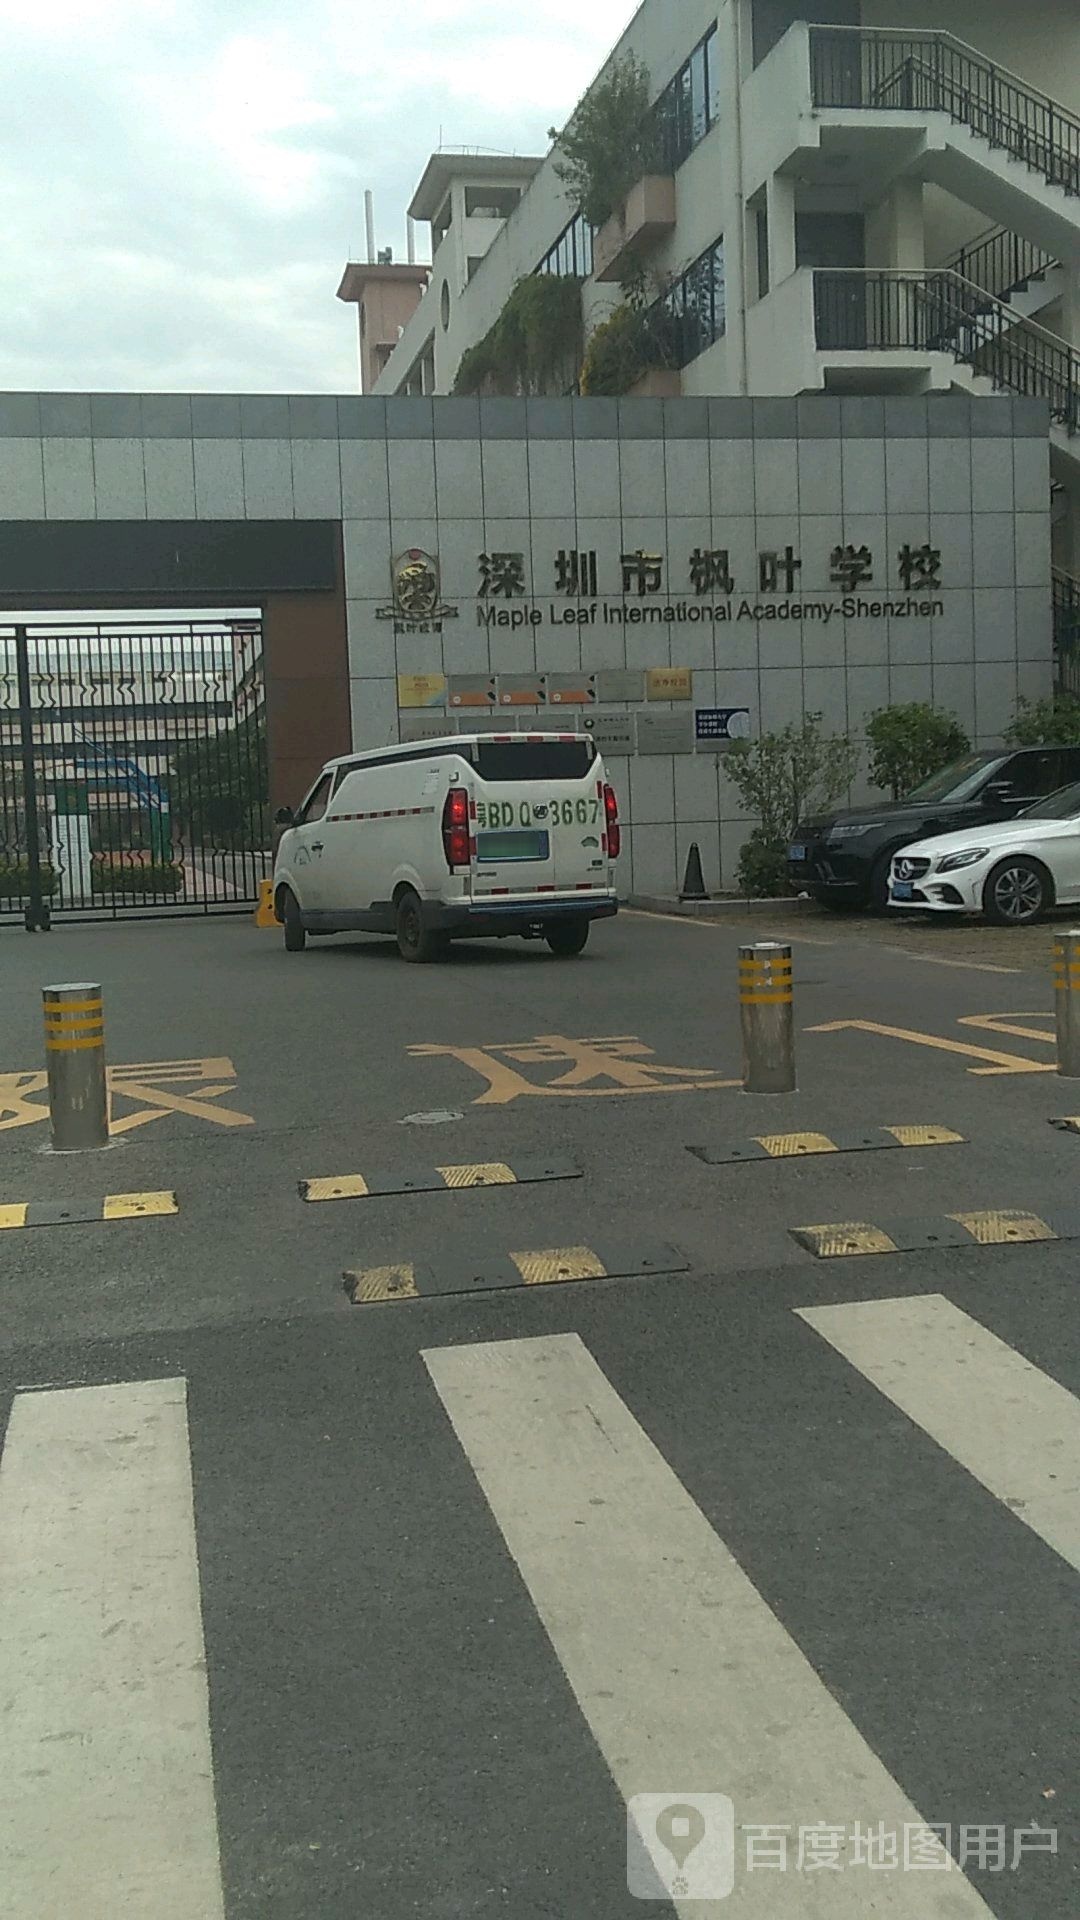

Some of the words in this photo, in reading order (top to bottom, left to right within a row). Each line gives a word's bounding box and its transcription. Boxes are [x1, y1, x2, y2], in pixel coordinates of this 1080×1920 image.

[477, 545, 943, 597] 深圳市枫叶学校
[477, 605, 541, 628] Maple
[550, 601, 596, 622] Leaf
[603, 598, 732, 622] International
[738, 596, 944, 622] Academy-Shenzhen
